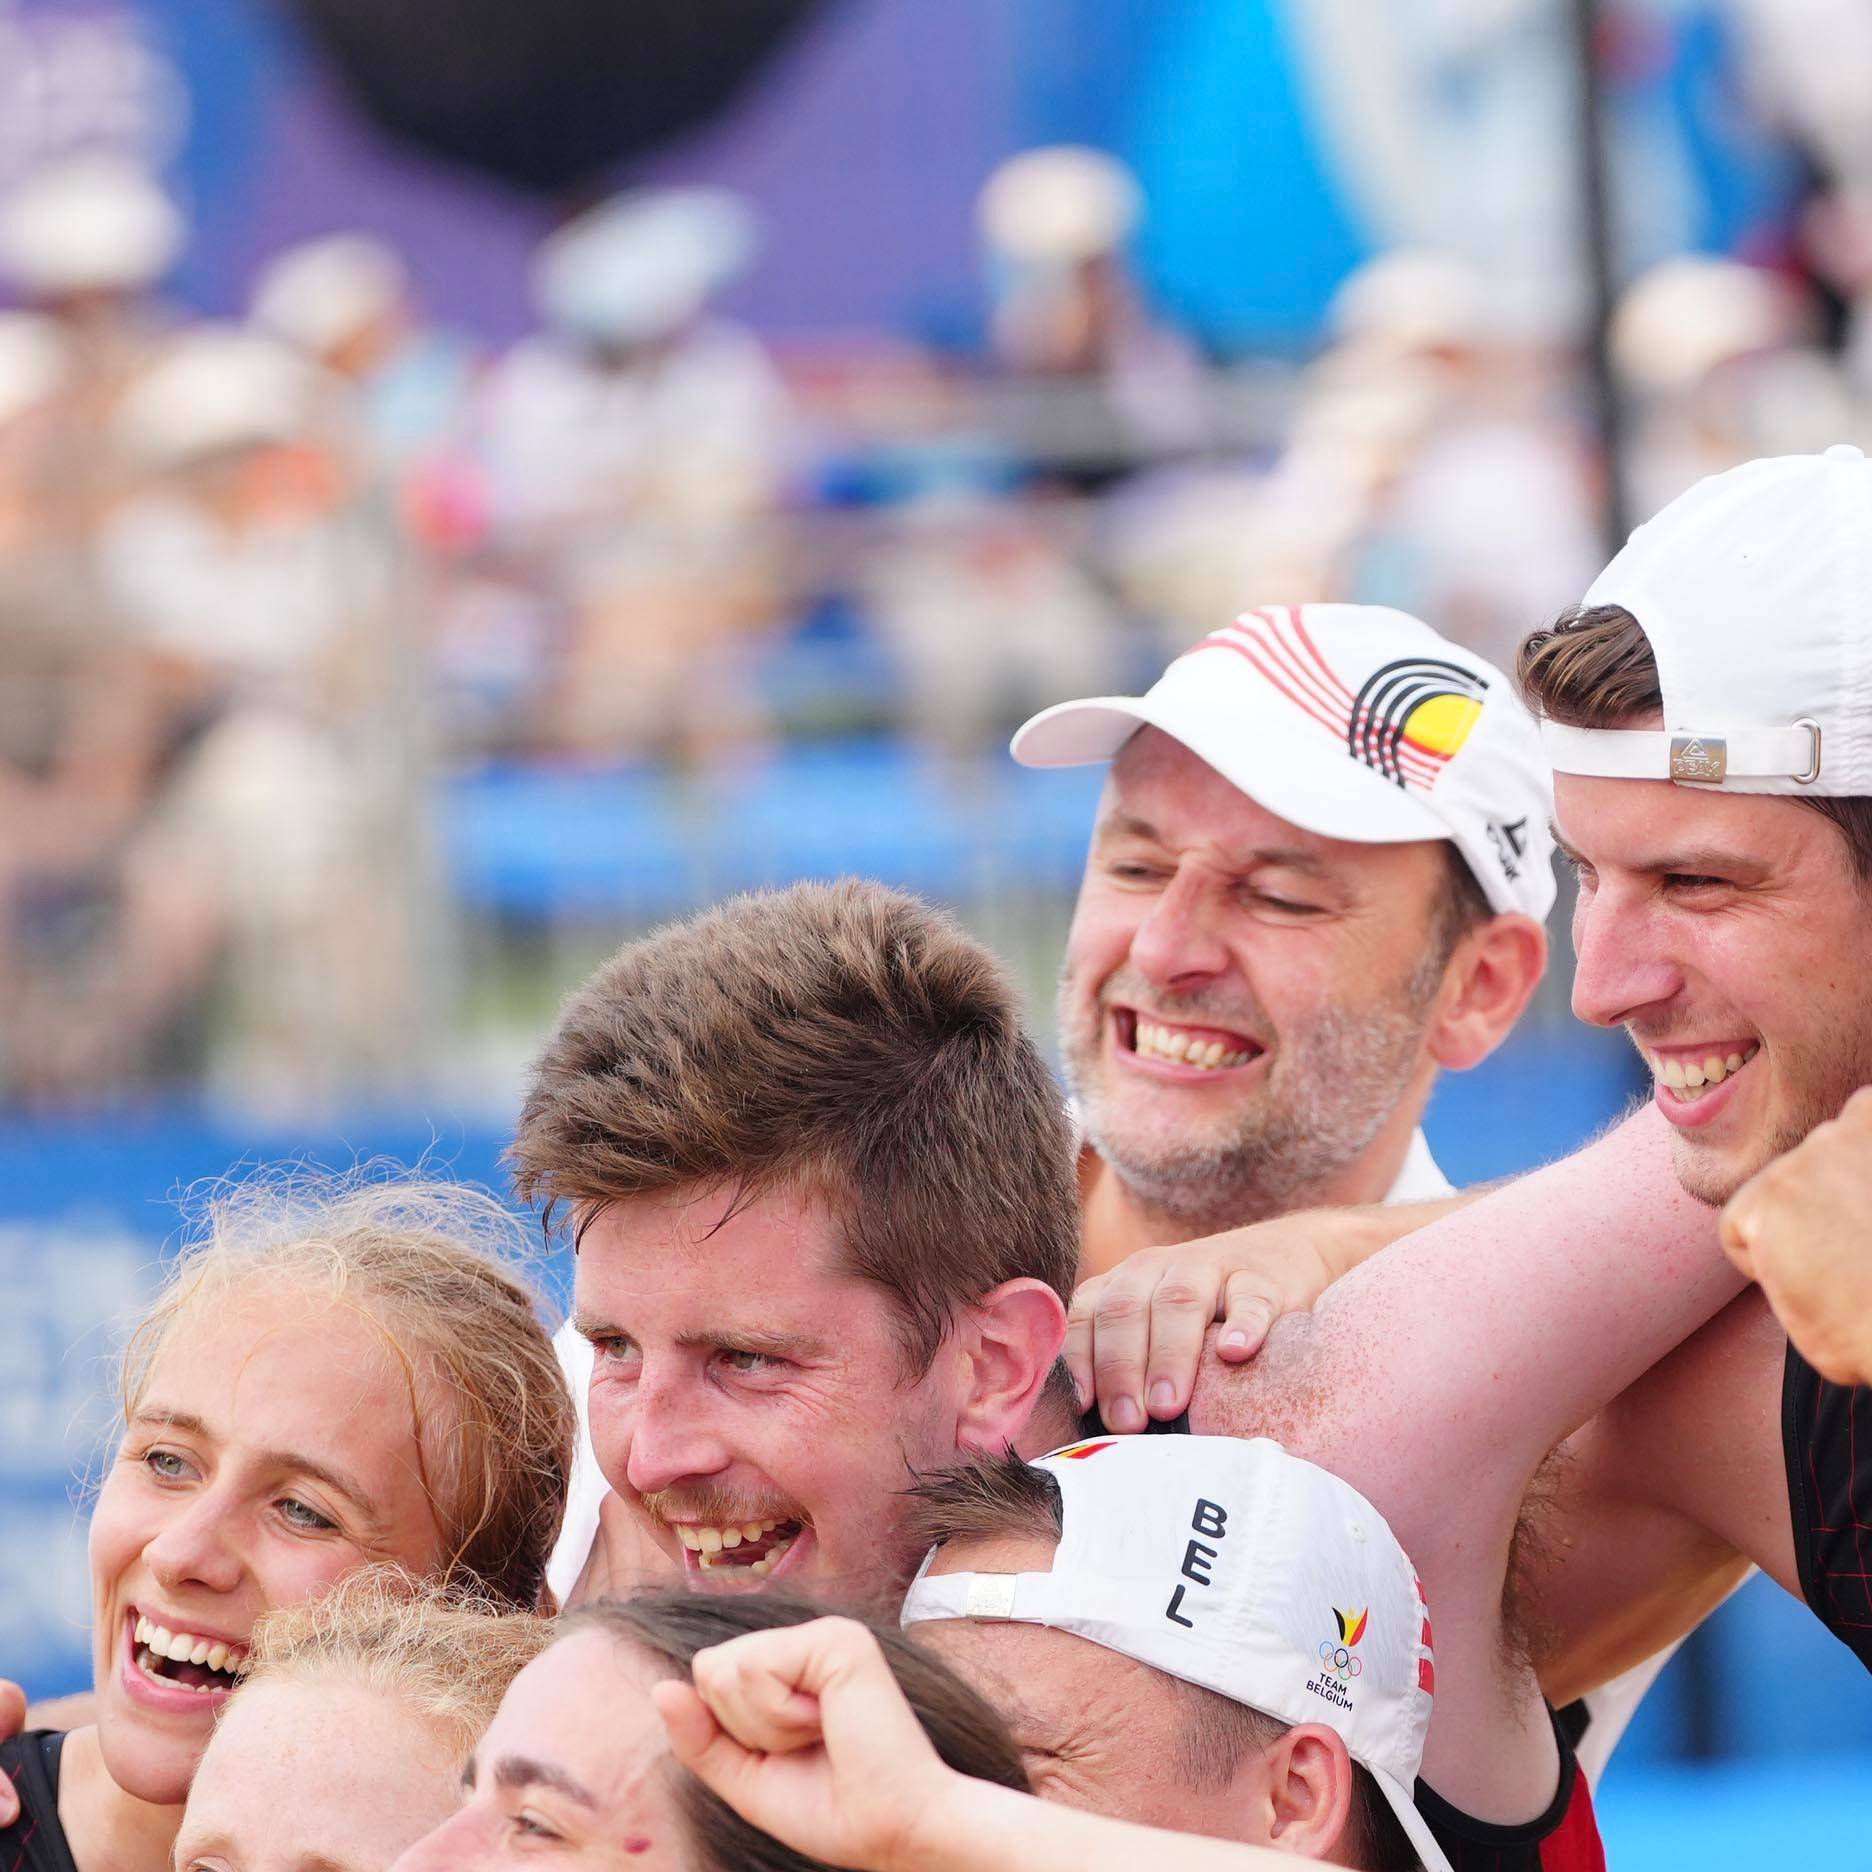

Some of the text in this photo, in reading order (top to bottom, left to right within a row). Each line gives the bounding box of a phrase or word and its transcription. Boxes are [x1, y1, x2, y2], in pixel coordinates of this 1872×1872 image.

[1165, 1498, 1228, 1629] BEL
[1306, 1680, 1353, 1712] BELGIUM
[1319, 1672, 1347, 1696] TEAM
